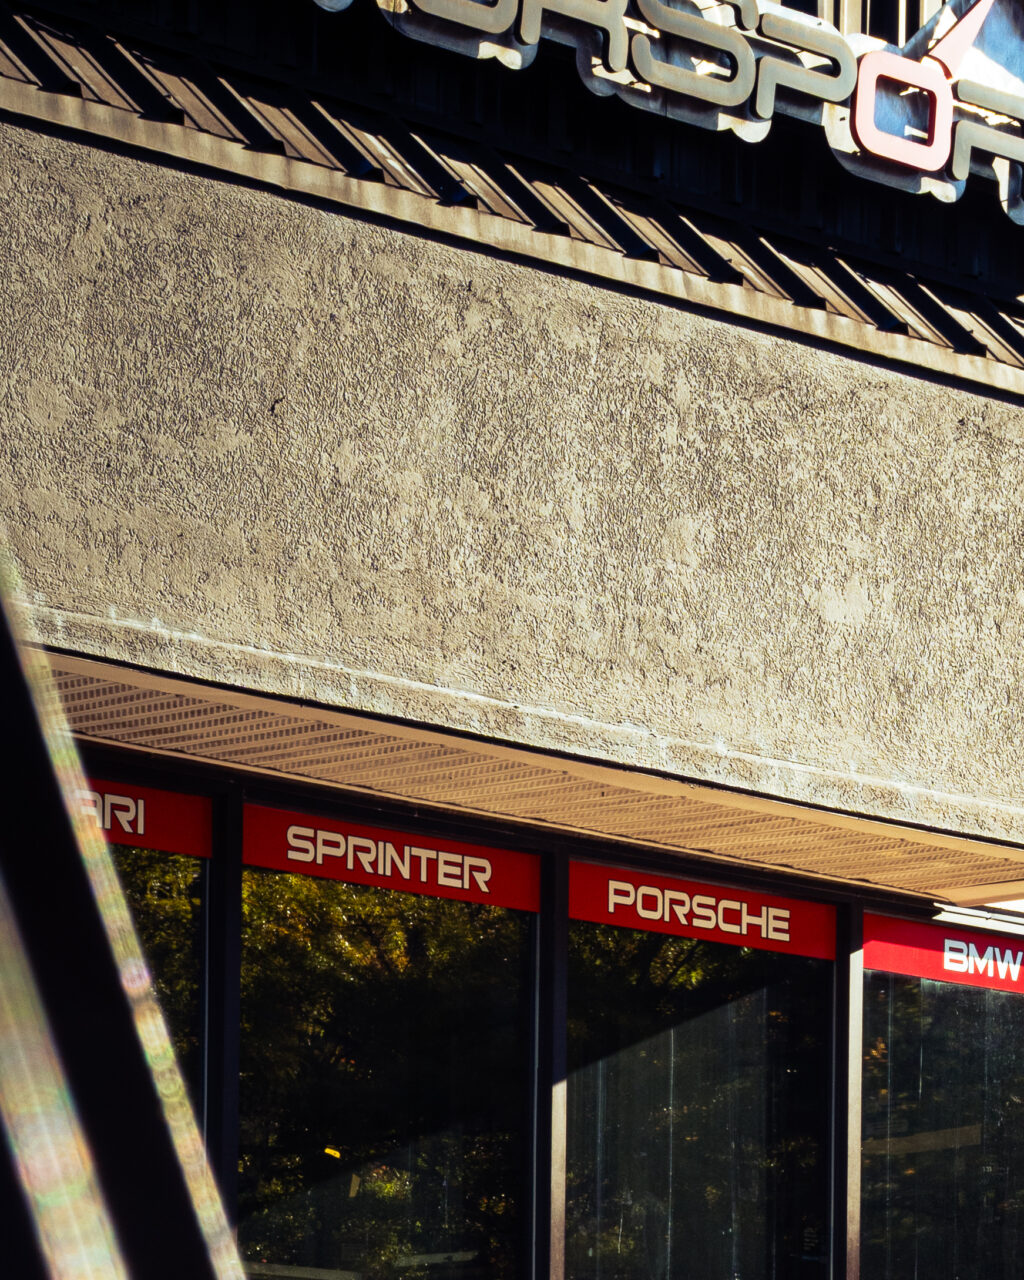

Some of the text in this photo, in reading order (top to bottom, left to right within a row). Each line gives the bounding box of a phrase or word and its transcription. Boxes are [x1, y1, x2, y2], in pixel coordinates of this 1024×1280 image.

[286, 825, 492, 893] SPRINTER
[608, 879, 791, 942] PORSCHE
[943, 938, 1024, 982] BMW
